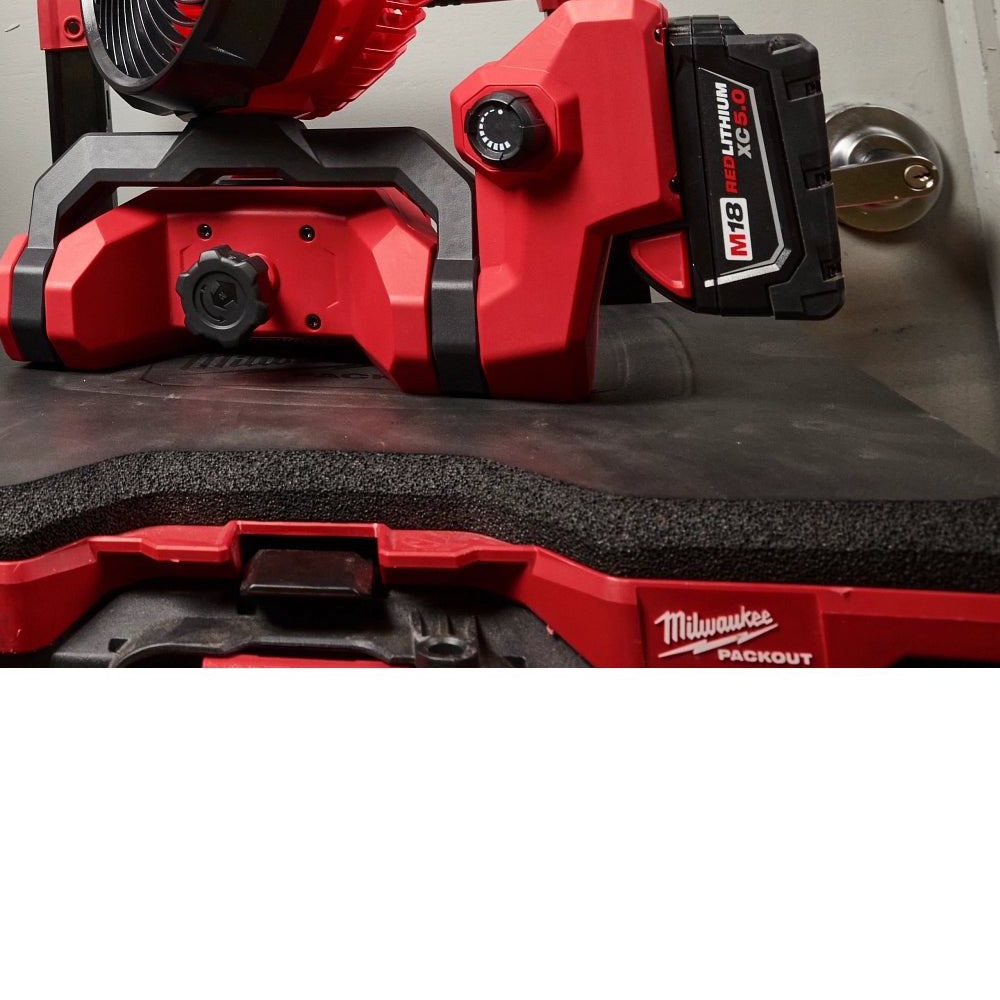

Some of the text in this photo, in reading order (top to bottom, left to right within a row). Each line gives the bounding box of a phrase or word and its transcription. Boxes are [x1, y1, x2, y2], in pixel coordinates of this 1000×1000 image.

[715, 81, 738, 194] REDLITHIUM
[726, 201, 748, 257] M18
[654, 606, 774, 645] Milwaukee
[717, 648, 813, 665] PACKOUT
